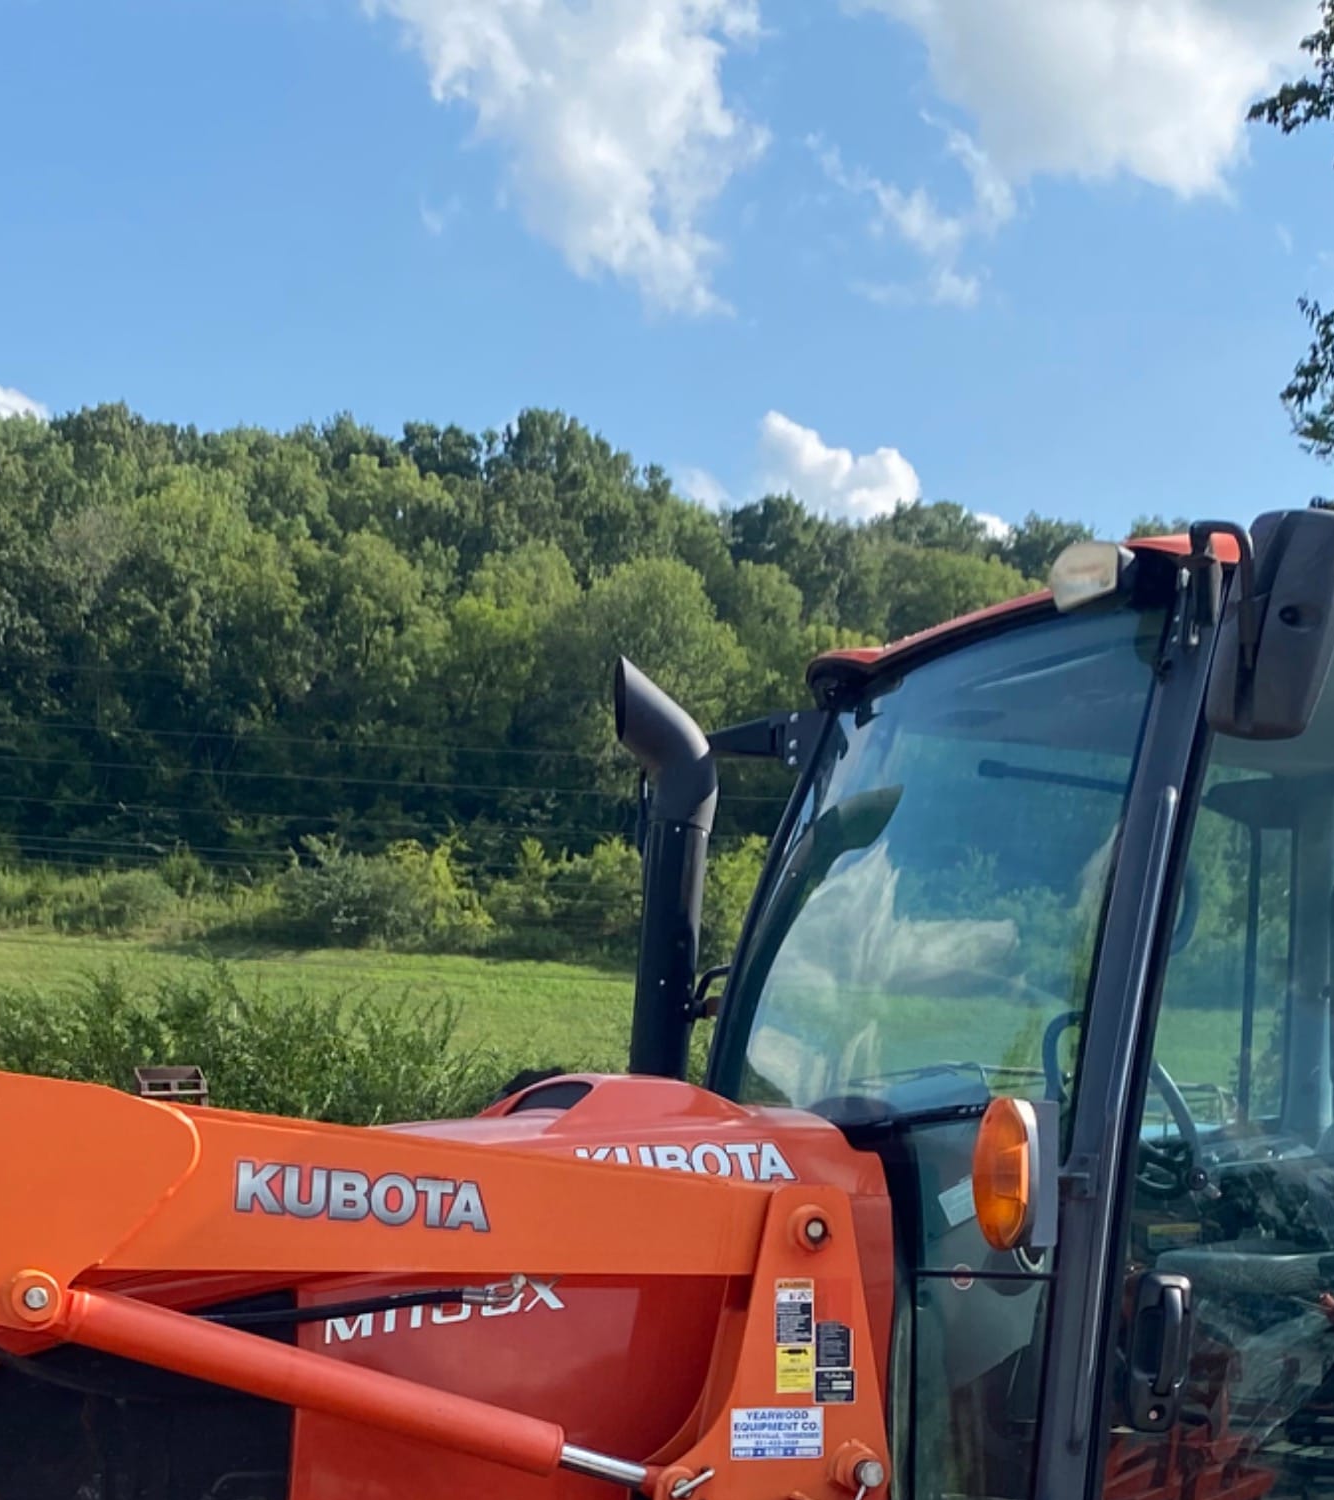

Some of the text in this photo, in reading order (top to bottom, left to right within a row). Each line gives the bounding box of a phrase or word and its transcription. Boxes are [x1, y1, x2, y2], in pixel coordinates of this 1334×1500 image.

[234, 1159, 492, 1233] KUBOTA
[747, 1410, 809, 1420] YEARWOOD
[734, 1422, 798, 1431] EQUIPMENT
